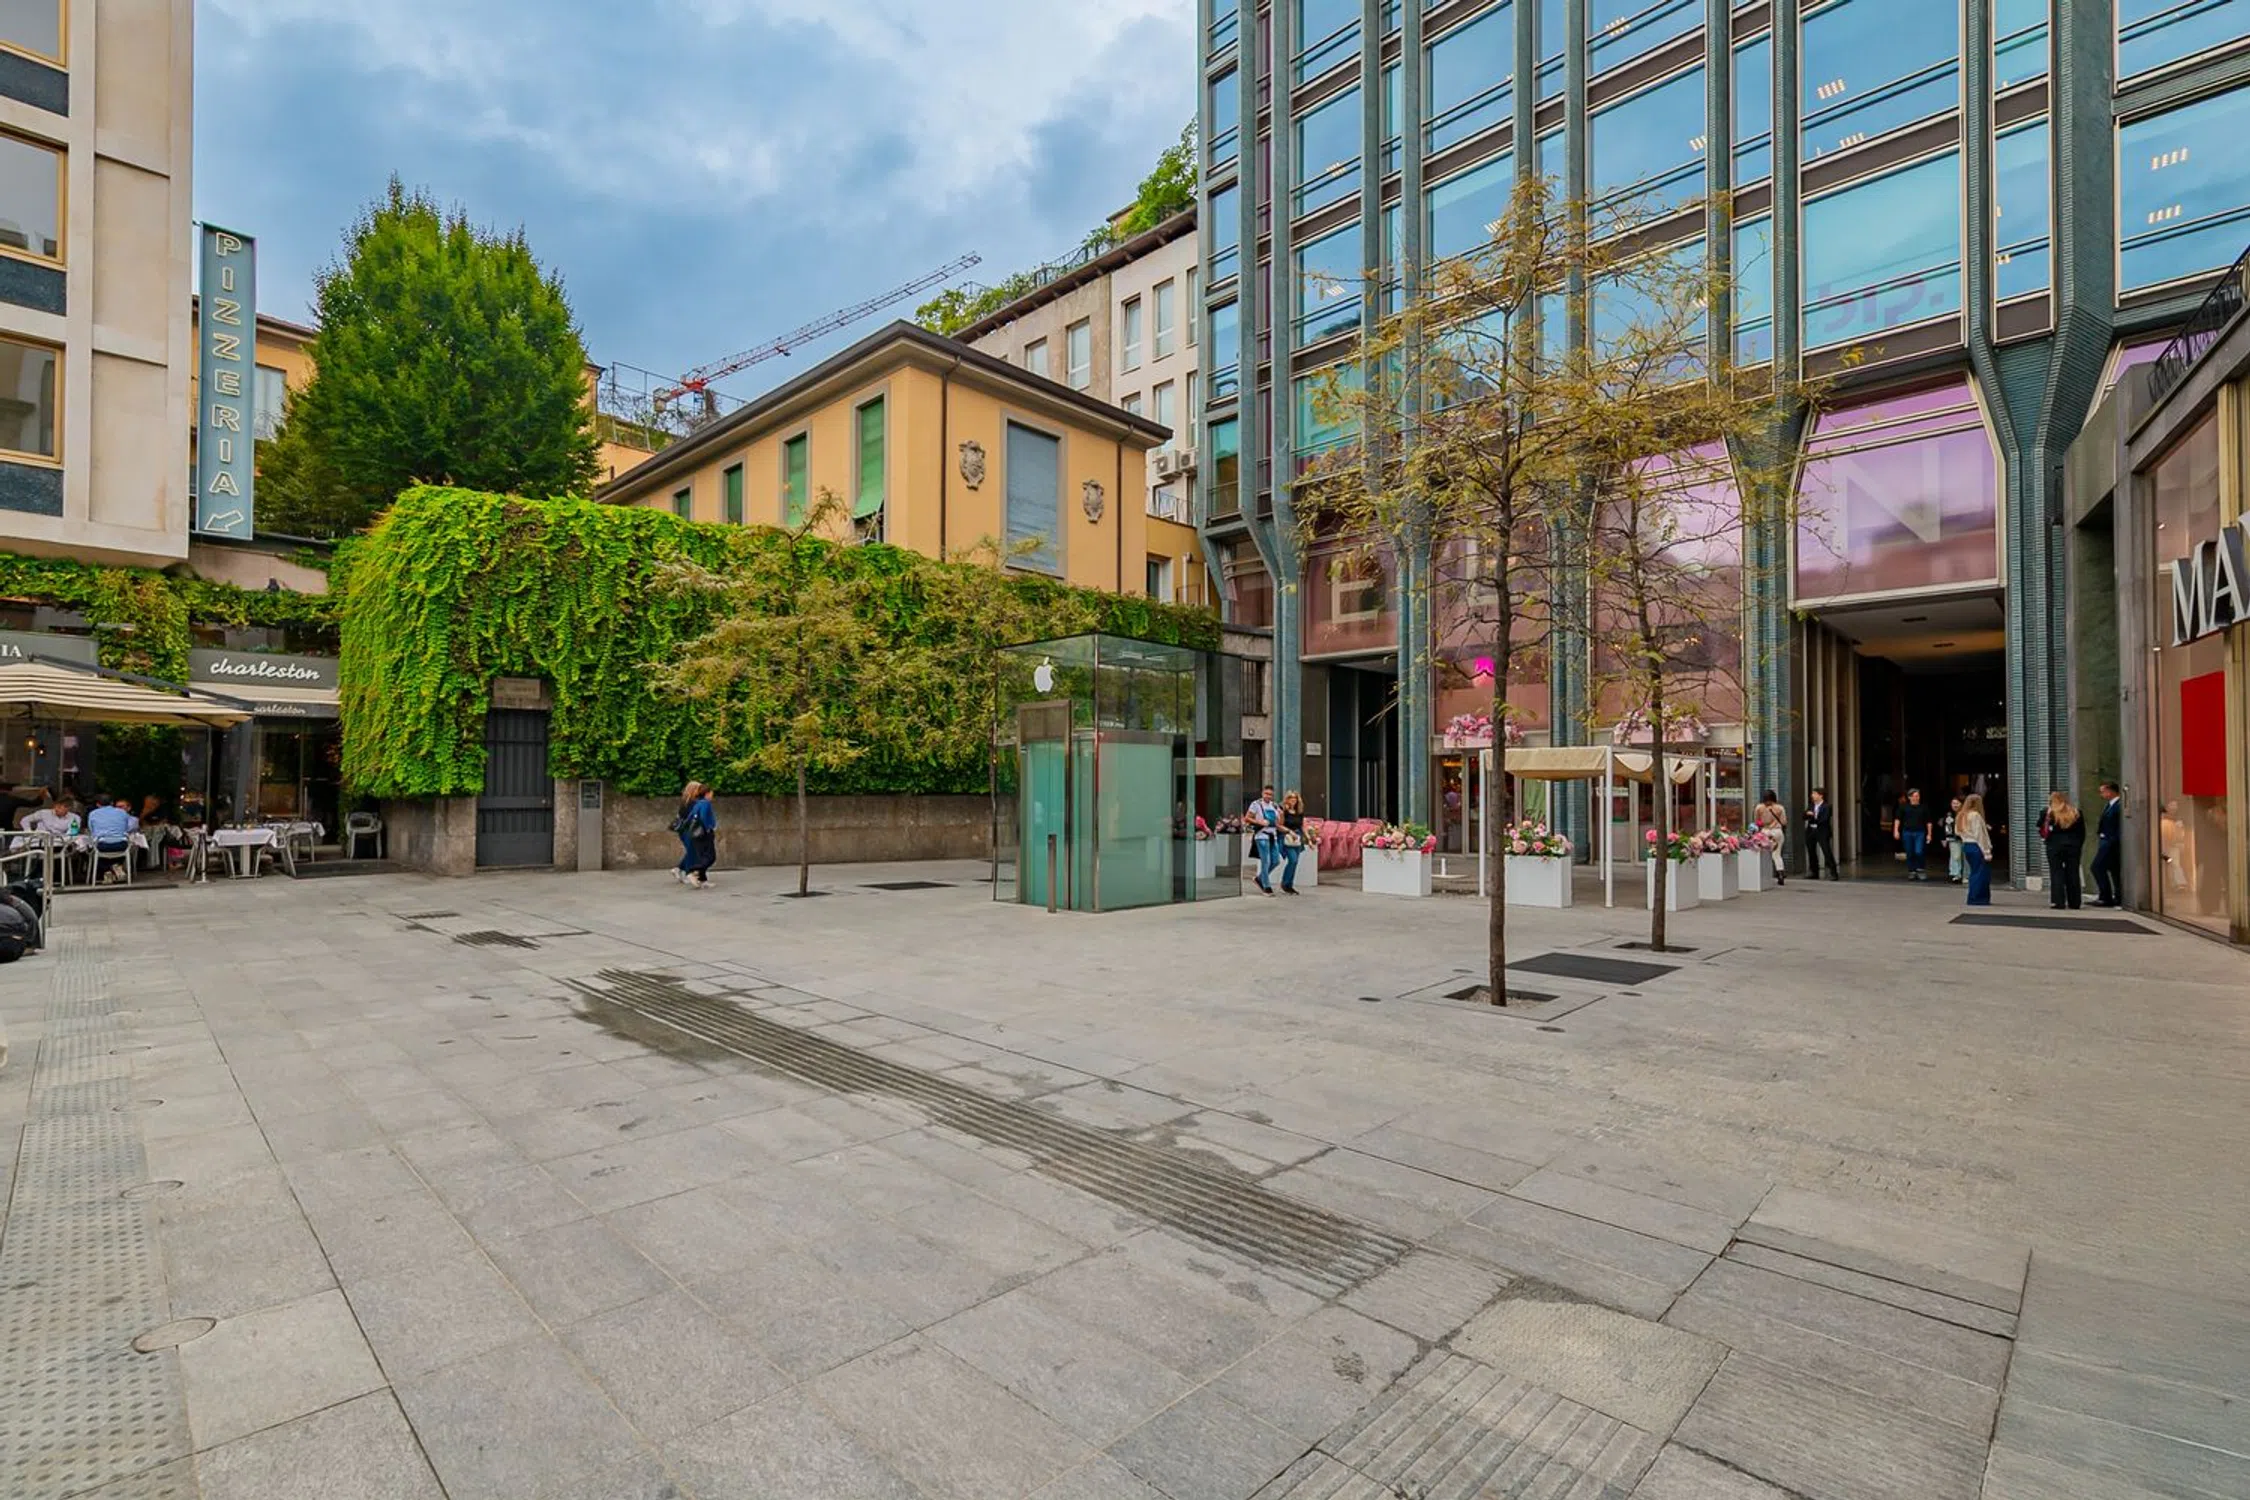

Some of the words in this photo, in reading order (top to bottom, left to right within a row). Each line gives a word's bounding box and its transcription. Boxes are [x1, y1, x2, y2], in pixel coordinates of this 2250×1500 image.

[209, 232, 241, 496] PIZZERIA
[2171, 511, 2250, 647] MA
[209, 658, 320, 681] charleston
